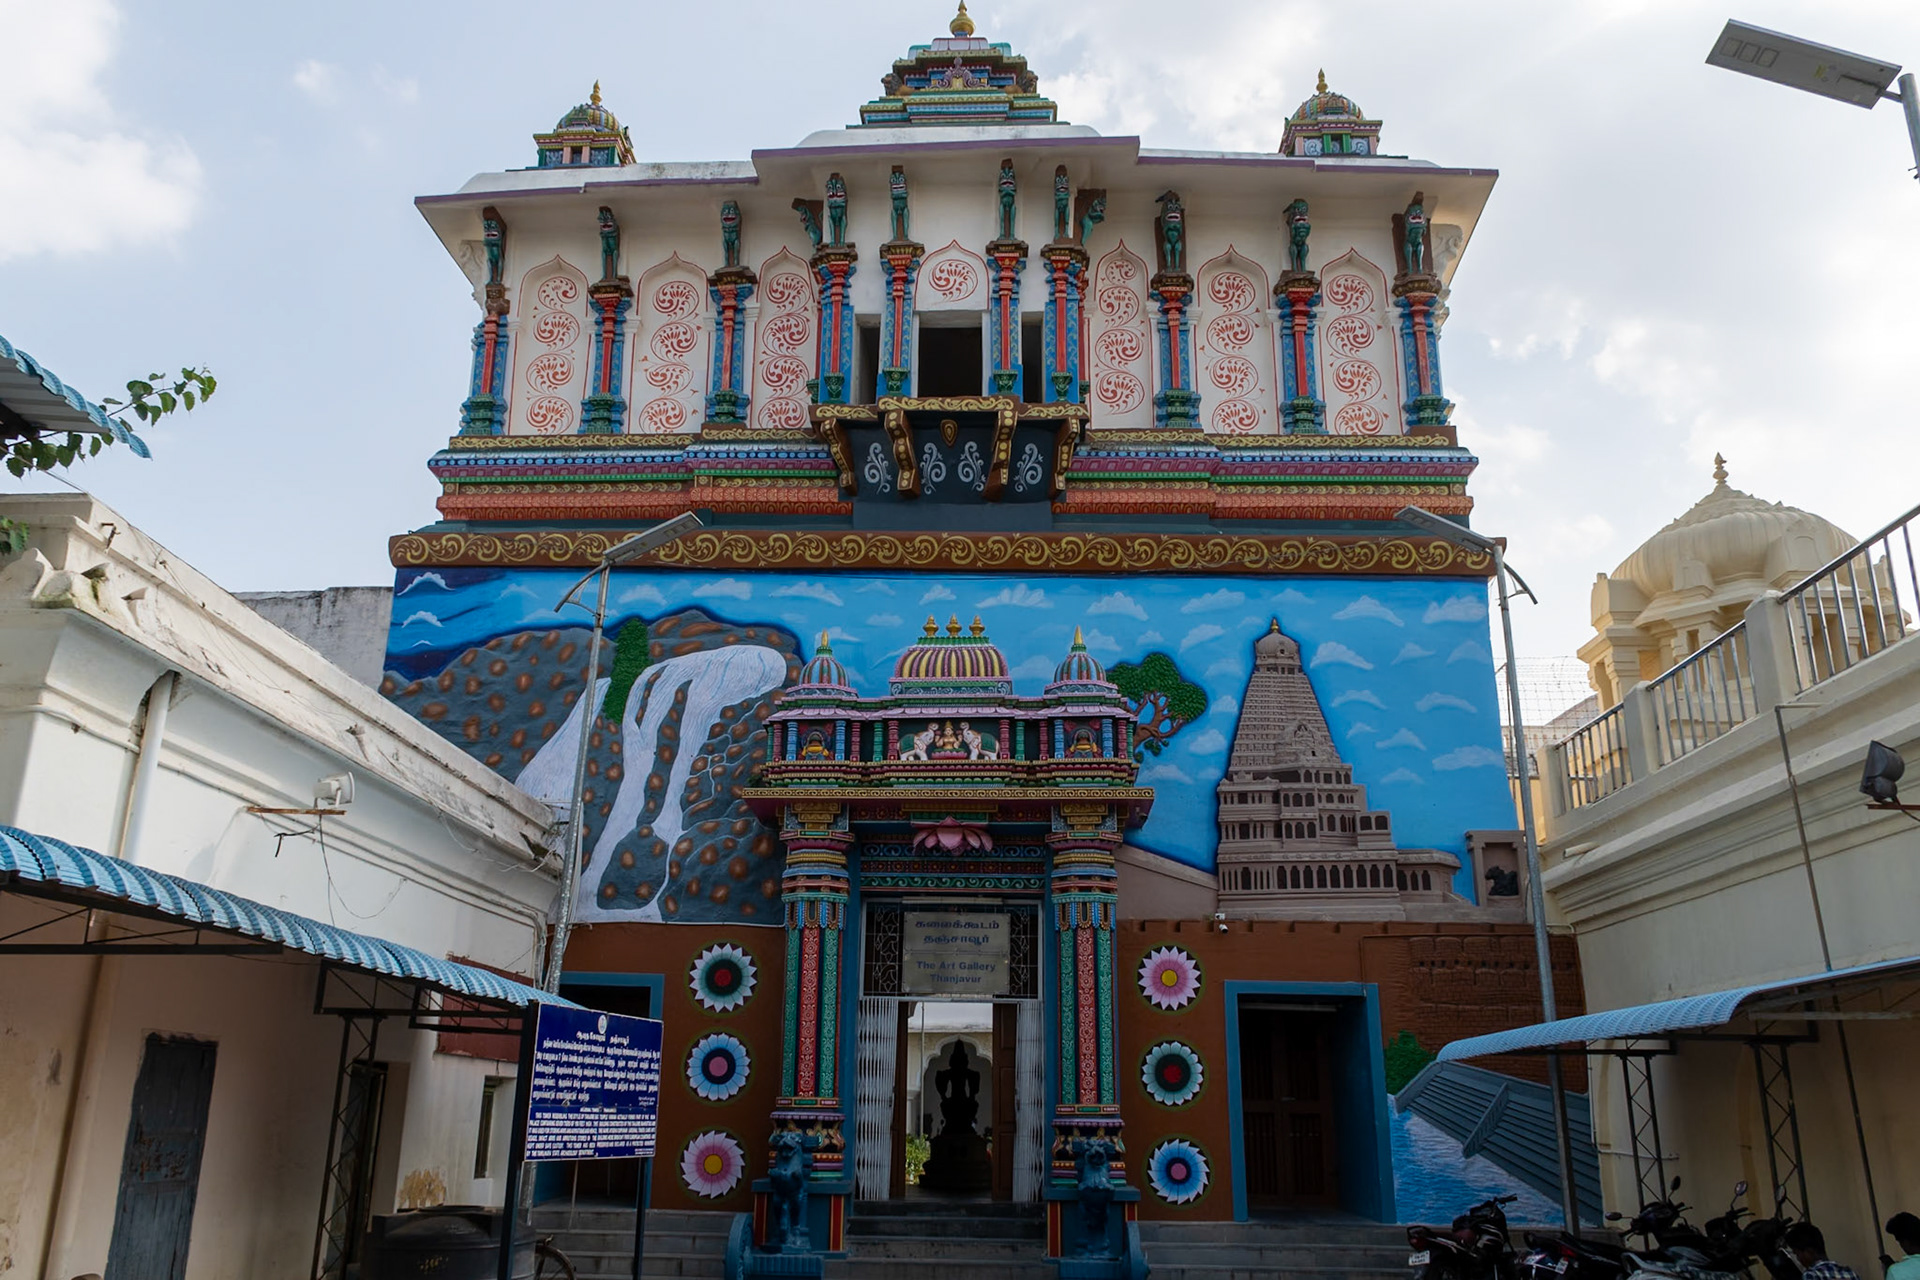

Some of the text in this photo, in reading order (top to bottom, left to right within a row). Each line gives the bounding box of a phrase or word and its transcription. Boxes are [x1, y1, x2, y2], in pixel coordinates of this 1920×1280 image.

[915, 919, 1000, 930] கலைக்கூடம்
[923, 934, 990, 946] தஞ்சாவூர்
[917, 961, 996, 972] The Art Gallery
[930, 974, 982, 984] Thanjavur
